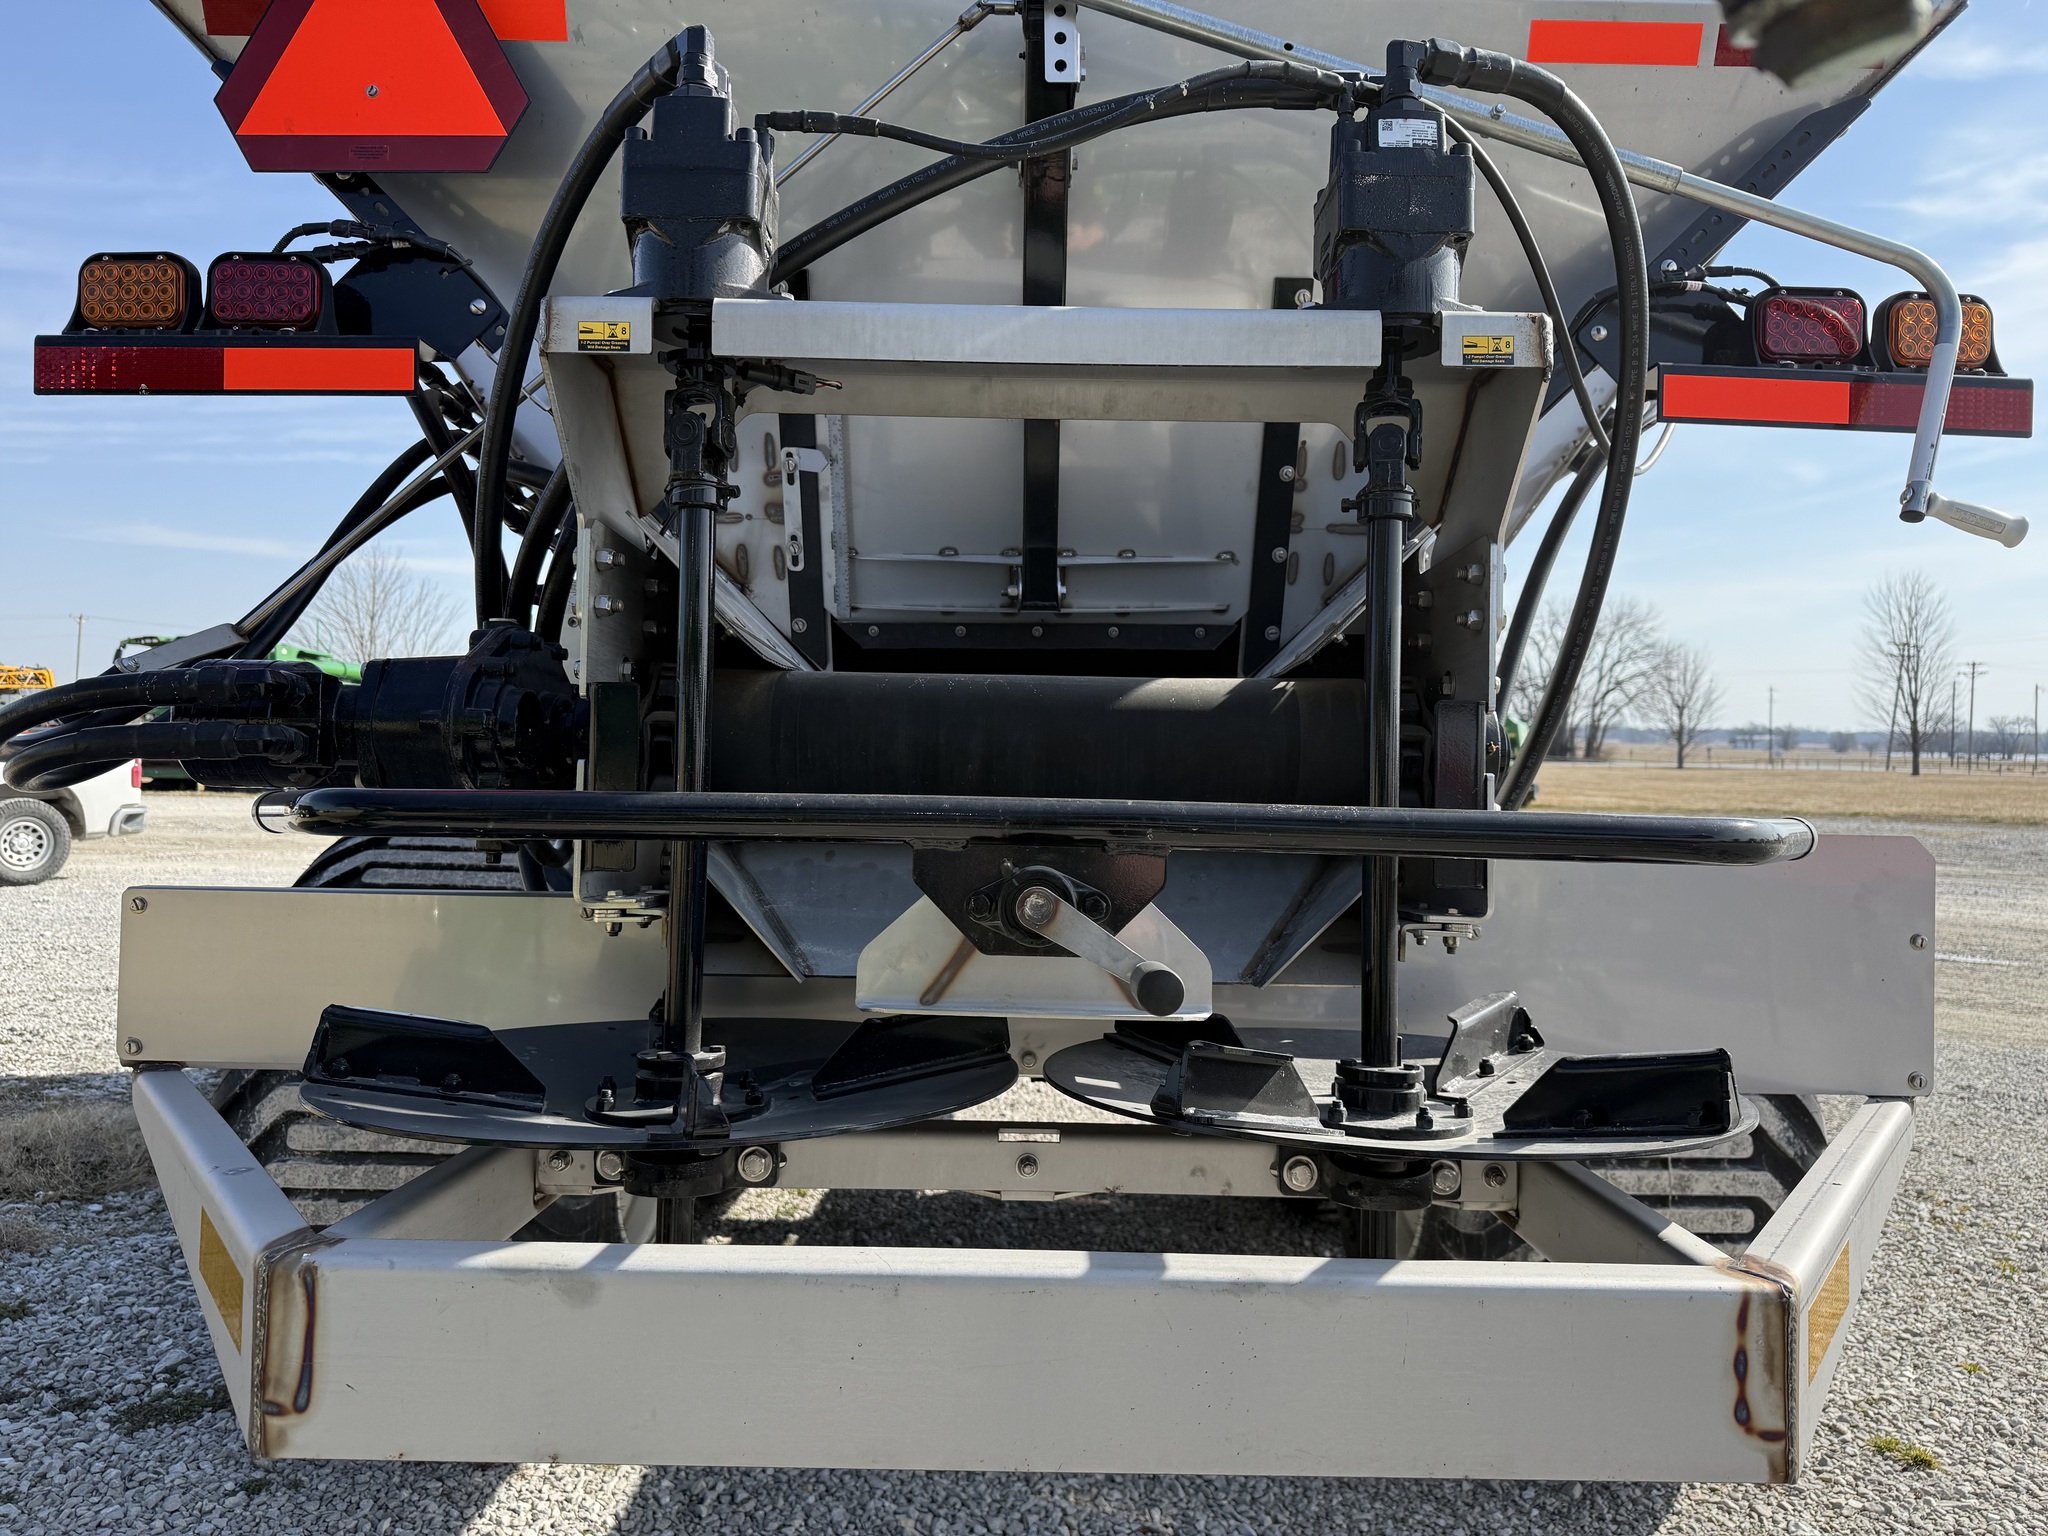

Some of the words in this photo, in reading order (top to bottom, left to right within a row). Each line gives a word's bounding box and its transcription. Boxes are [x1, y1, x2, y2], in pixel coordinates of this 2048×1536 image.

[1017, 127, 1035, 139] MADE
[1053, 114, 1075, 127] ITALY
[1589, 141, 1604, 158] ITALY
[1606, 171, 1626, 218] ALFAGOMMA
[803, 232, 816, 242] R16
[826, 211, 851, 229] SAE100
[854, 202, 867, 214] R17
[878, 188, 896, 201] MSHA
[515, 268, 534, 316] ALFAGOMMA
[1630, 275, 1638, 295] ITALY
[1632, 300, 1638, 308] IN
[622, 327, 626, 335] 8
[1632, 335, 1639, 343] 24
[1630, 369, 1638, 386] TYPE
[1609, 500, 1620, 524] SAE100
[1604, 536, 1612, 548] R16
[1597, 552, 1608, 576] SAE100
[1572, 647, 1580, 655] EN
